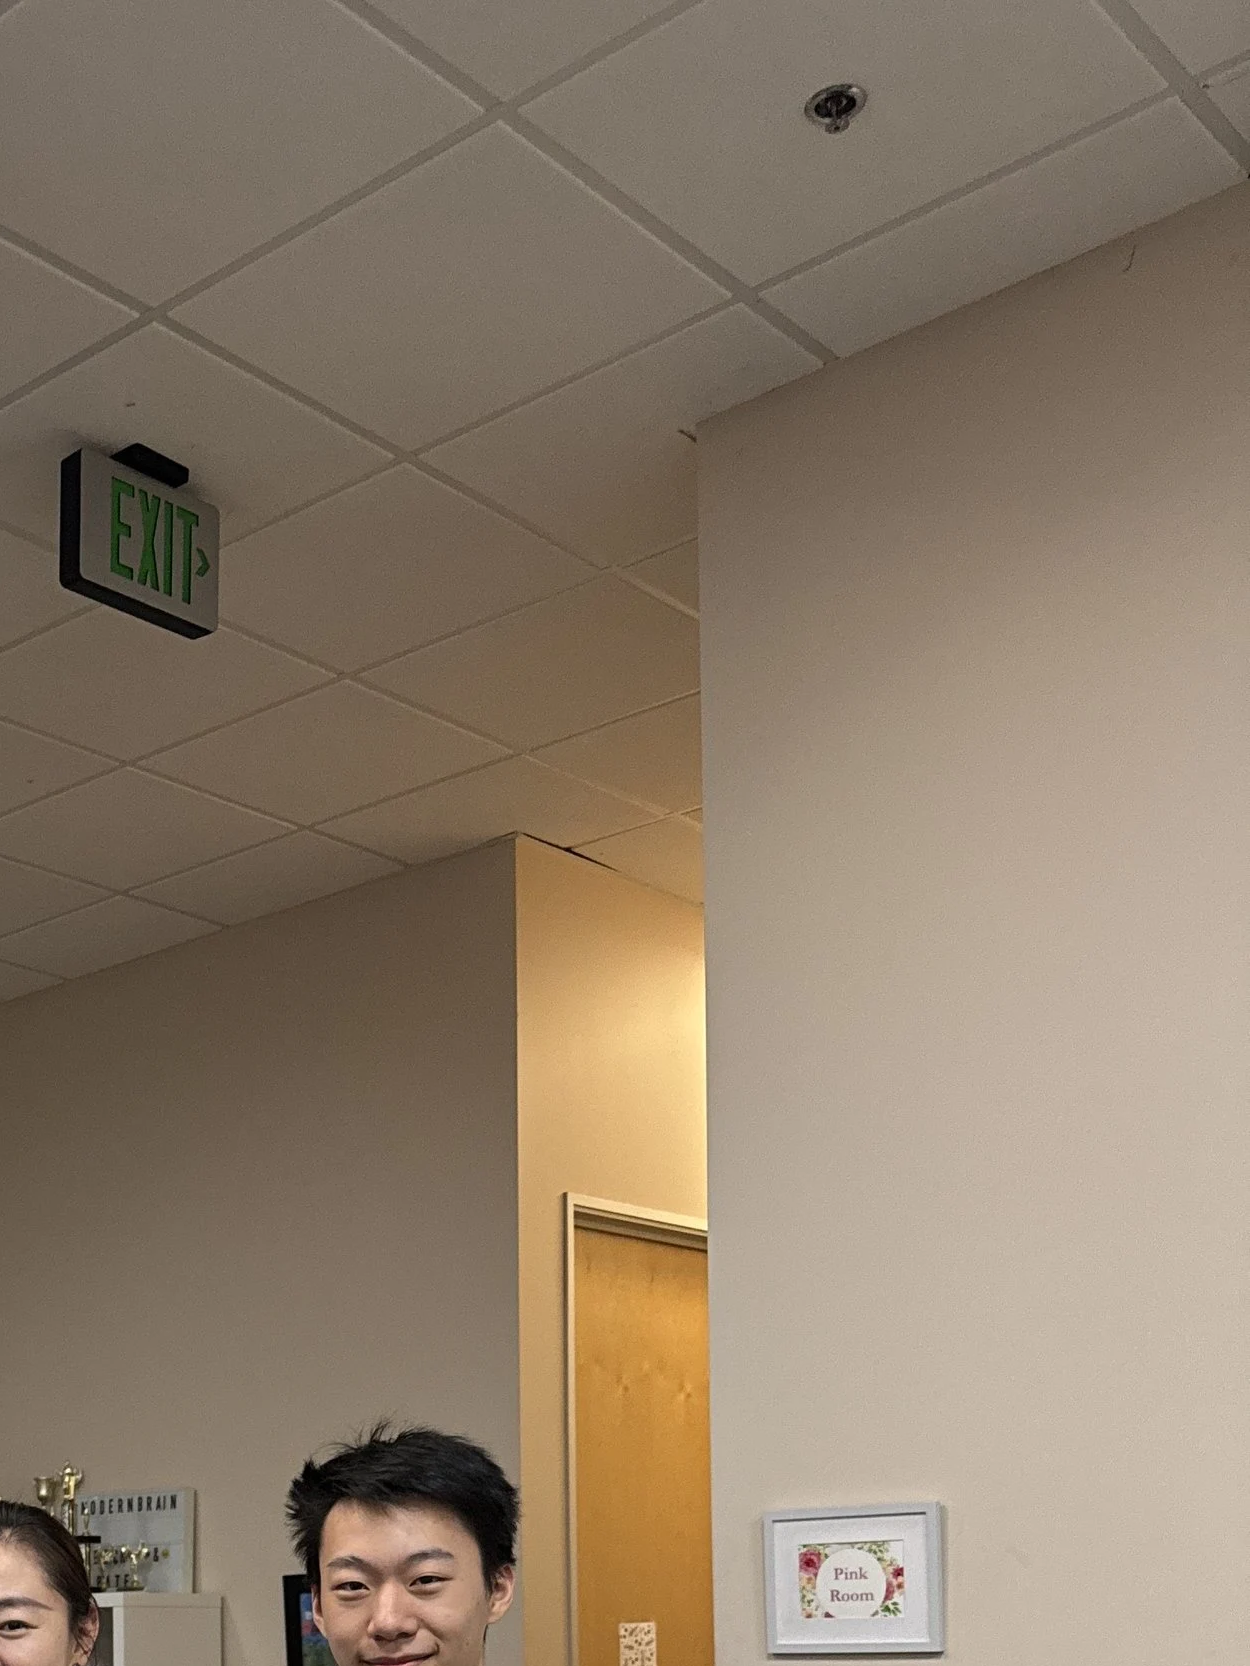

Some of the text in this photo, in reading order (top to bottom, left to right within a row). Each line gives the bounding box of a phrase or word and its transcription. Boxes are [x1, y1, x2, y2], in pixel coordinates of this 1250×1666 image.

[110, 476, 199, 605] EXIT
[834, 1567, 869, 1581] Pink
[830, 1589, 874, 1603] Room
